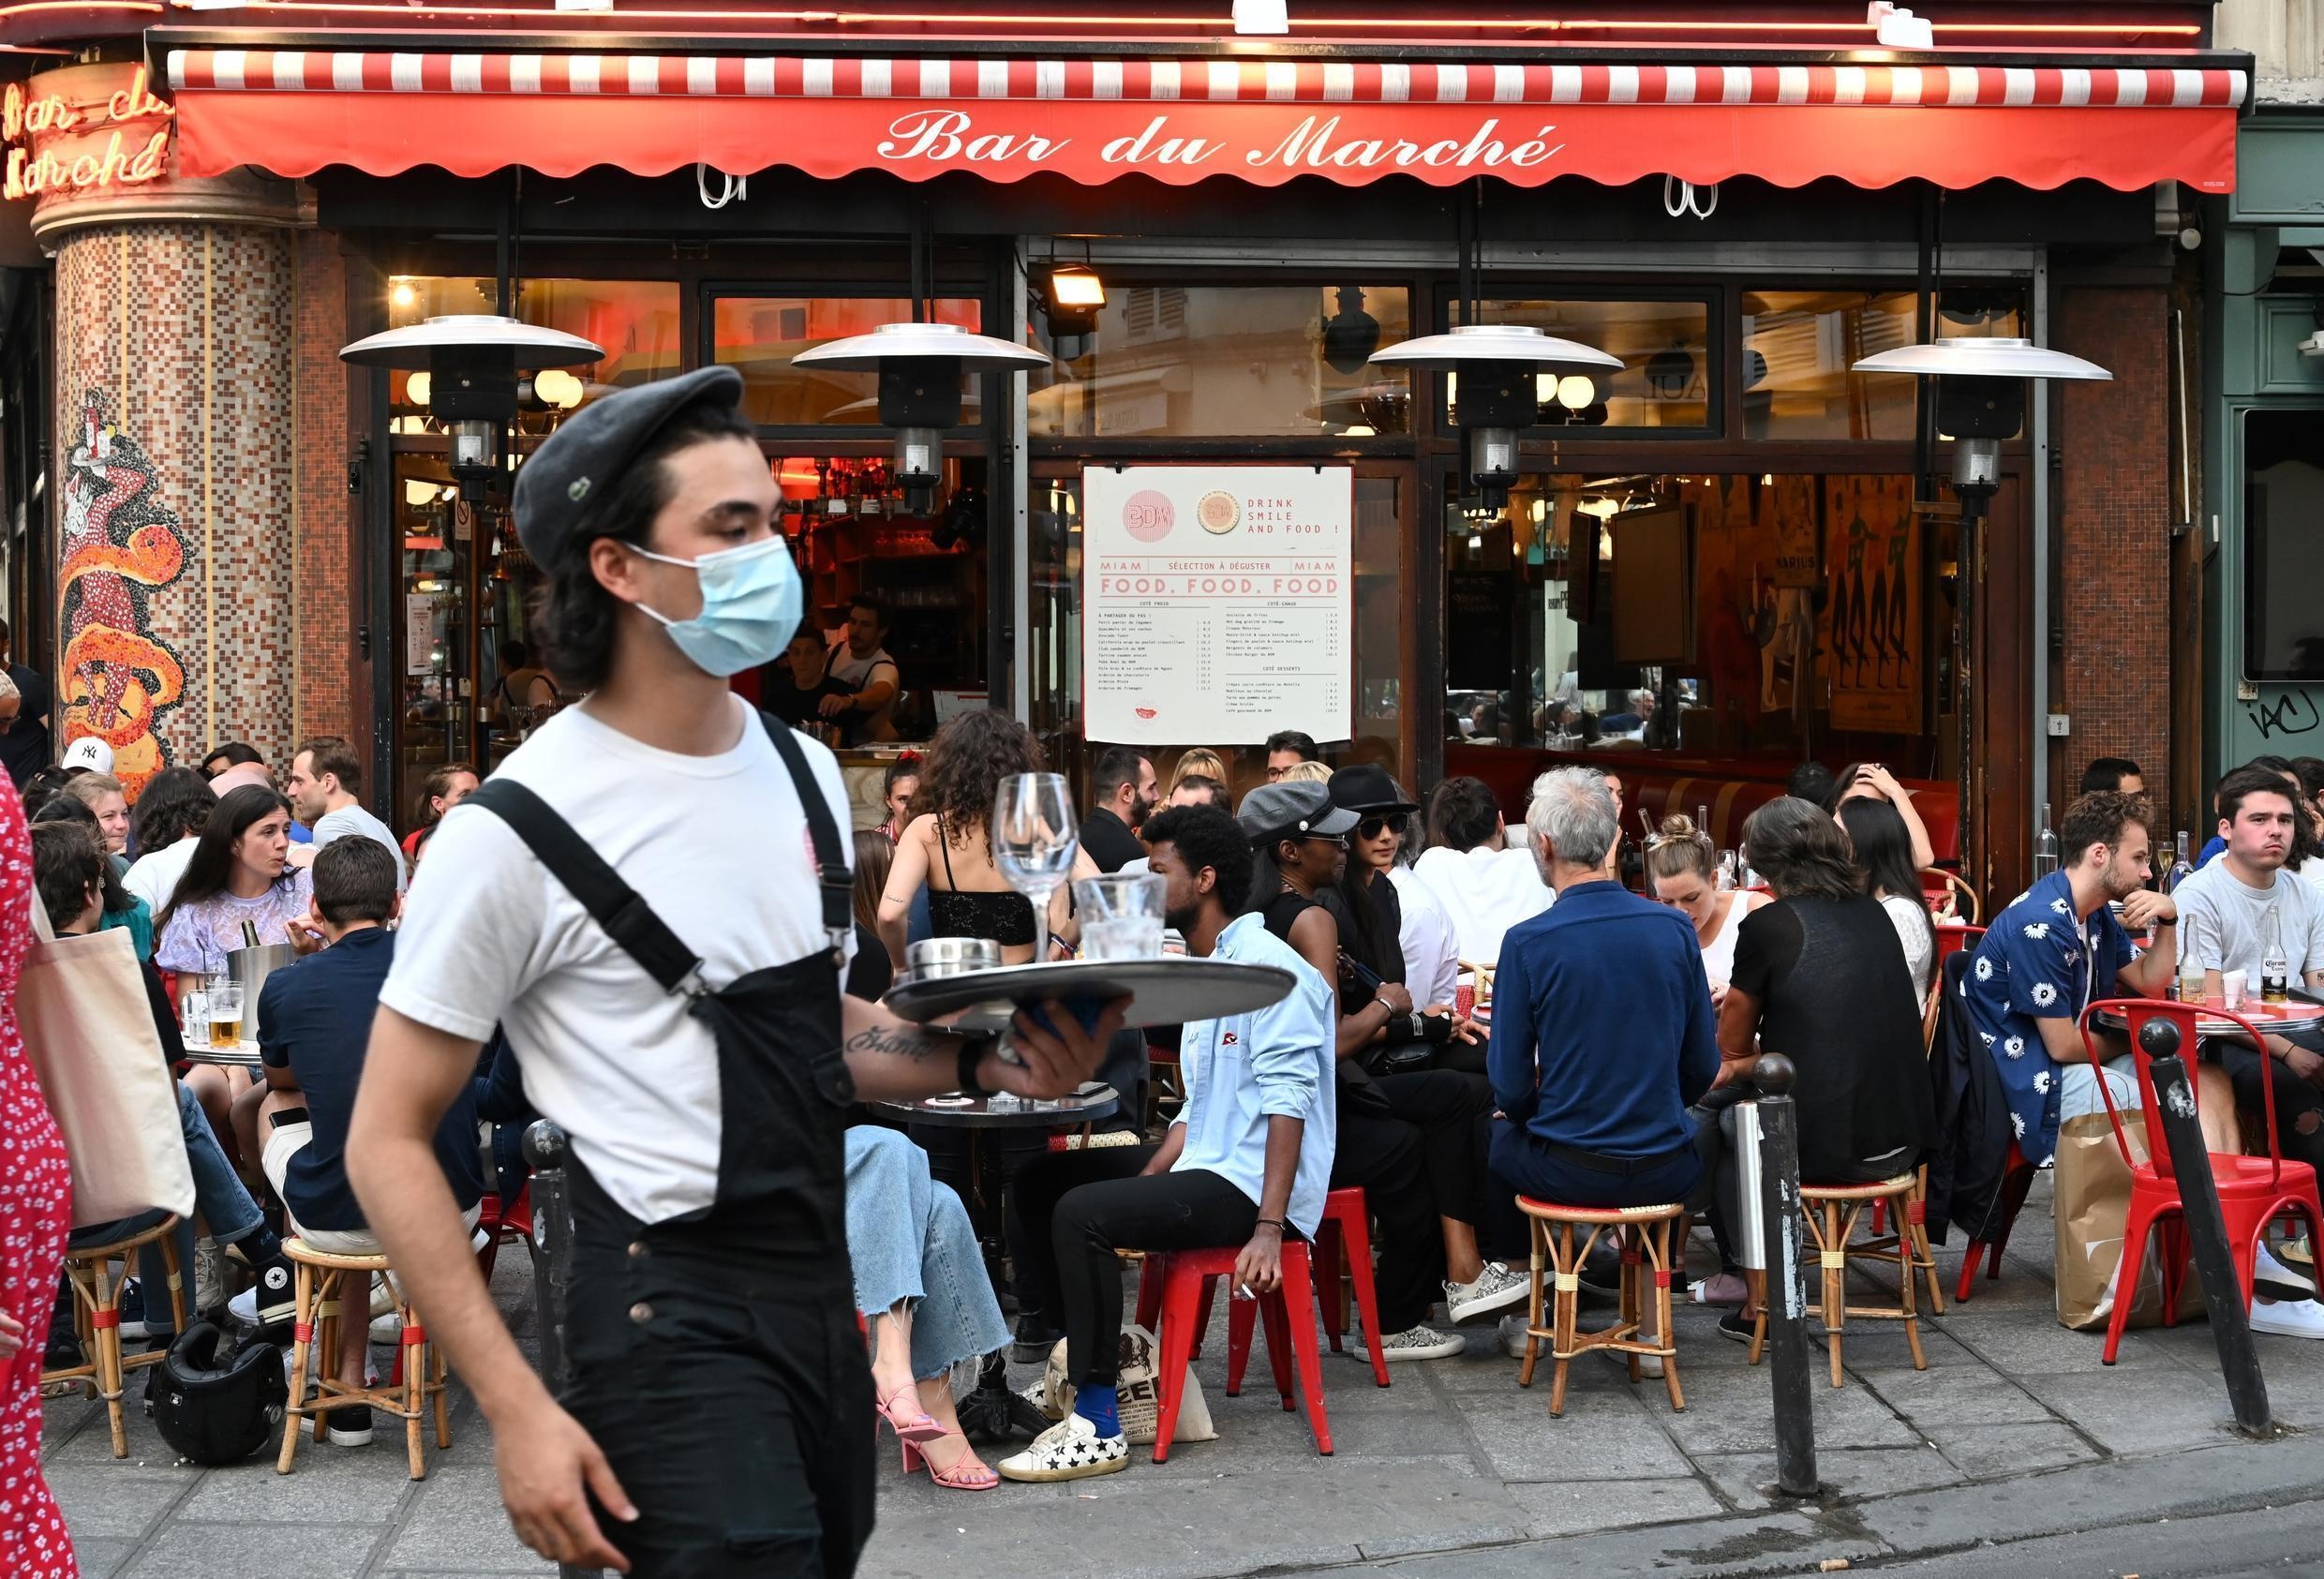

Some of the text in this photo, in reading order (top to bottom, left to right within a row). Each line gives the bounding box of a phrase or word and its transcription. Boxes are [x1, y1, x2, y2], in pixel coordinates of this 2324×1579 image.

[2, 82, 79, 141] Bar
[877, 109, 1565, 168] Bar du Marché
[1247, 499, 1292, 508] DRINK
[1128, 504, 1171, 529] BDM
[1247, 512, 1292, 521] SMILE
[1247, 524, 1274, 533] AND
[1286, 524, 1321, 533] FOOD
[1100, 562, 1141, 571] MIAM
[1169, 560, 1271, 571] SÉLECTION À DÉGUSTER
[1294, 562, 1336, 571] MIAM
[1101, 578, 1338, 594] FOOD. FOOD. FOOD
